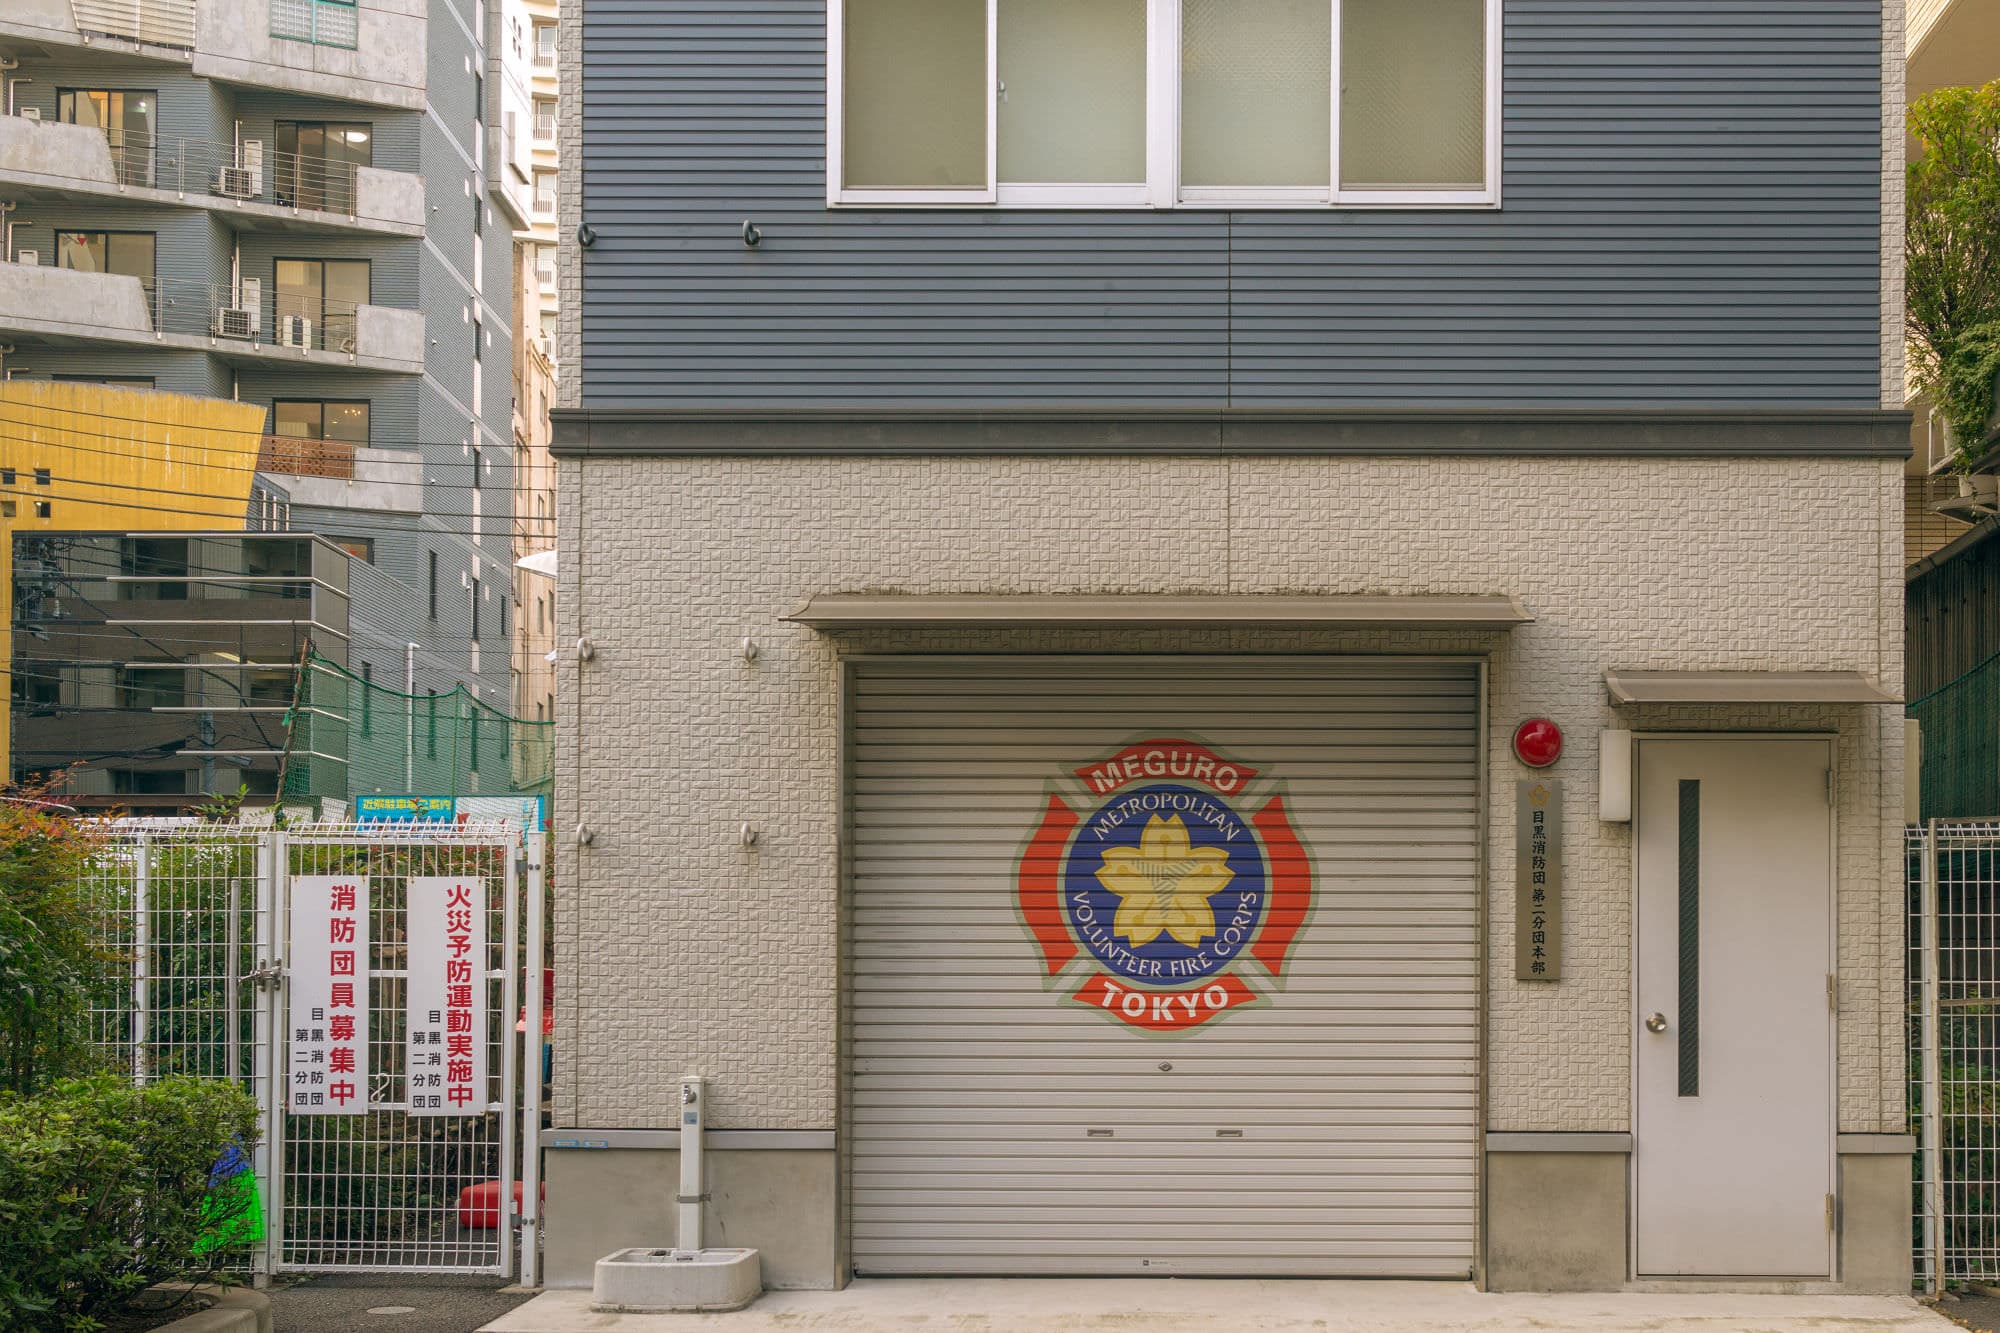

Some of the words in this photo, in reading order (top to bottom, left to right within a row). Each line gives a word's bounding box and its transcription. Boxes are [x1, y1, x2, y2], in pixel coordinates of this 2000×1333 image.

[1091, 750, 1238, 793] MEGURO
[1093, 793, 1240, 841] METROPOLITAN
[1073, 891, 1162, 977] VOLUNTEER
[1171, 952, 1212, 977] FIRE
[1214, 891, 1257, 956] CORPS
[329, 885, 356, 1106] 消防団員募集中
[446, 884, 473, 1108] 火災予防運動実施中
[1102, 981, 1229, 1021] TOKYO
[295, 1029, 308, 1106] 第二分団
[311, 1008, 324, 1106] 目黒消防団
[412, 1032, 425, 1109] 第二分団
[428, 1010, 441, 1108] 目黒消防団
